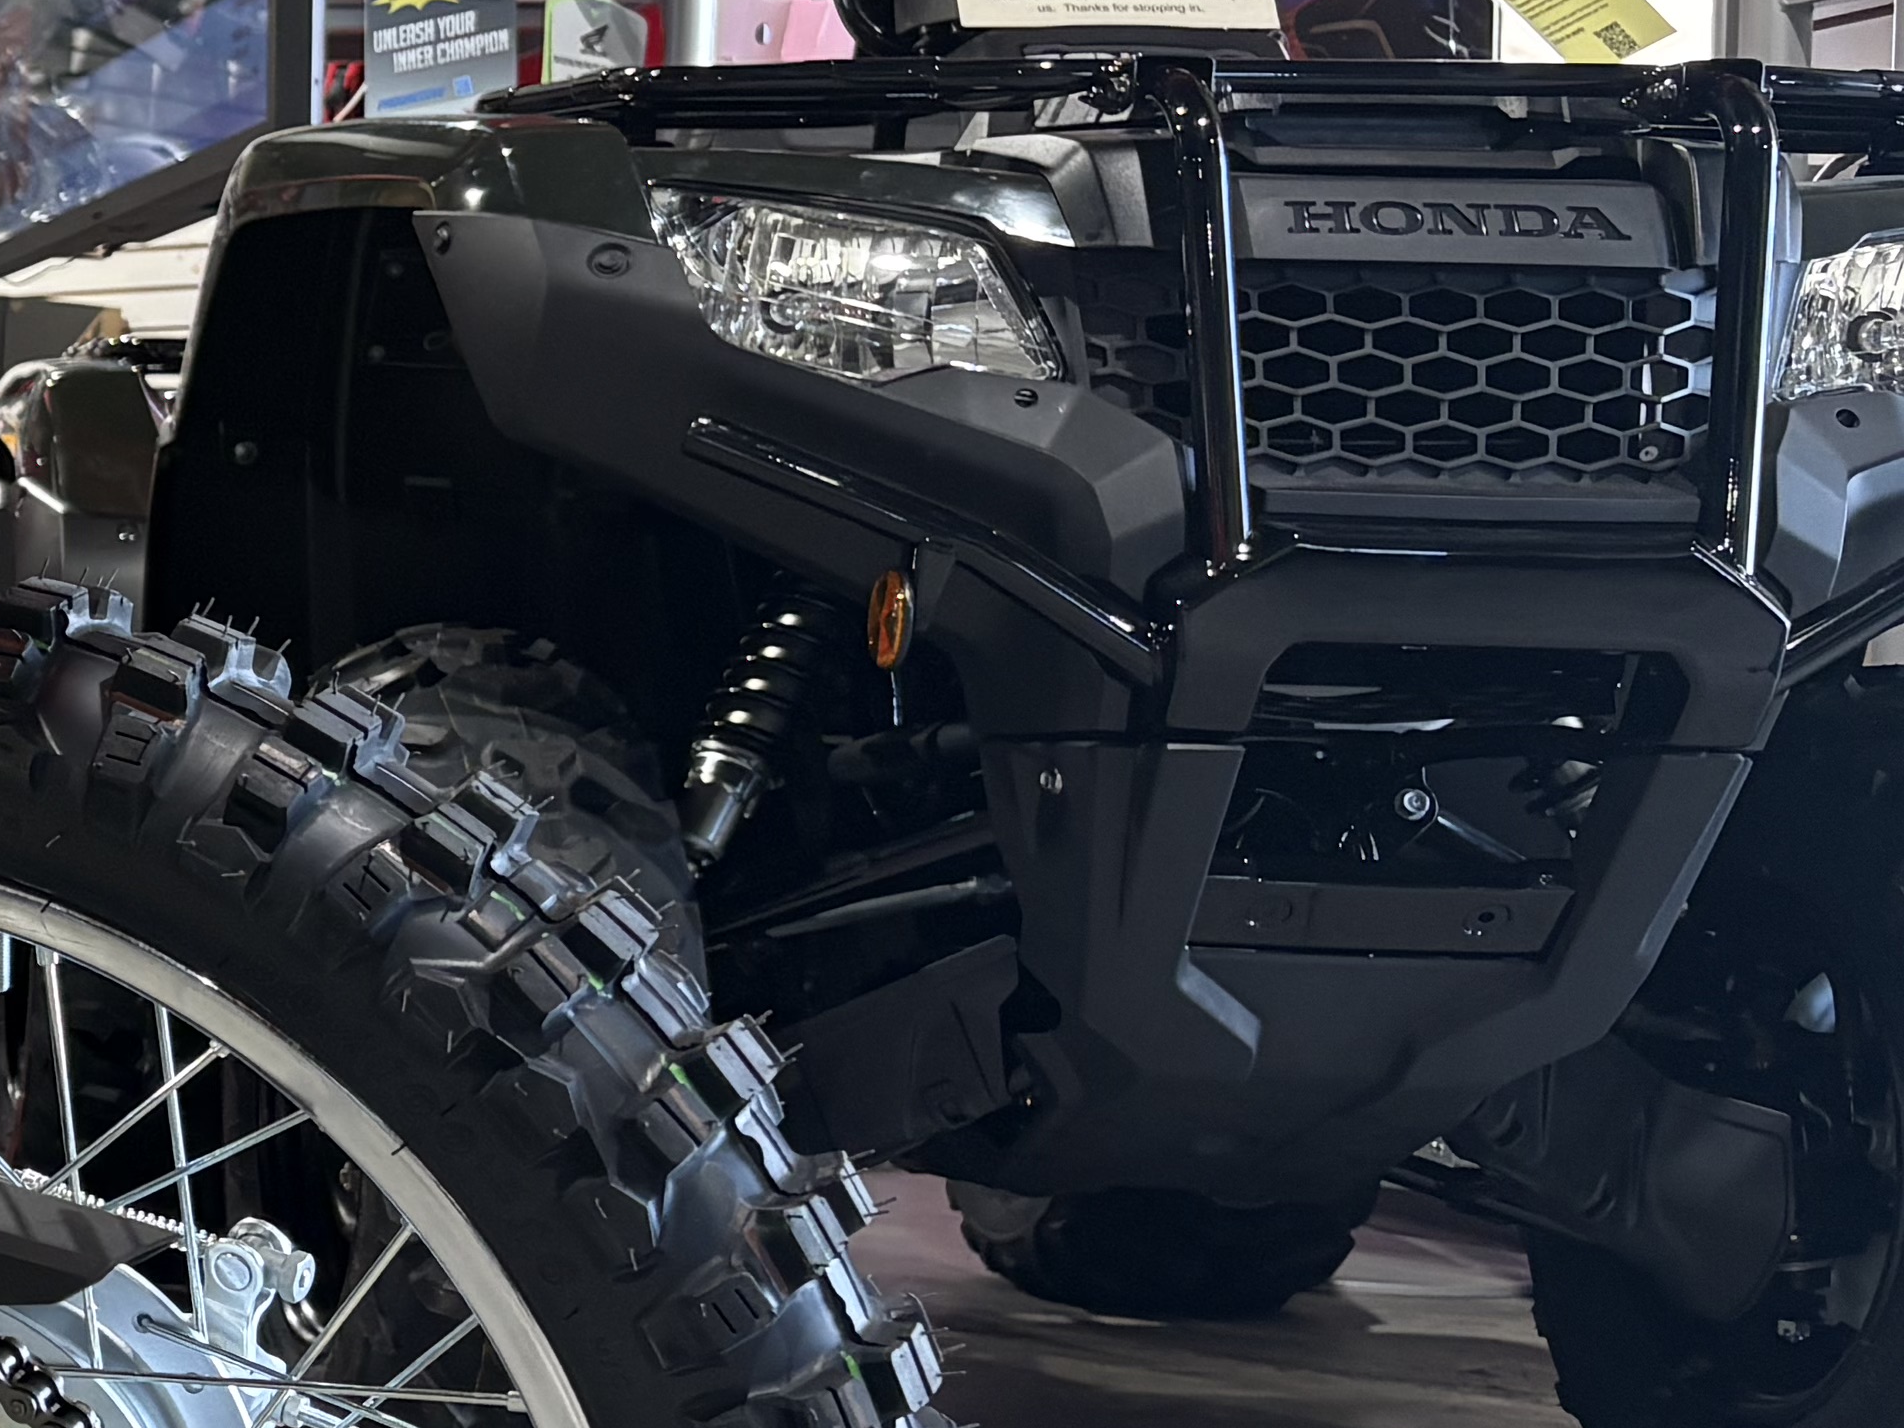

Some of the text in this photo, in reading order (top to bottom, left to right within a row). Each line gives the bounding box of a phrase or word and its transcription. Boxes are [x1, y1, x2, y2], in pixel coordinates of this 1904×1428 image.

[373, 10, 476, 53] UNLEASH YOUR
[393, 29, 510, 74] INNER CHAMPION
[1283, 199, 1632, 241] HONDA
